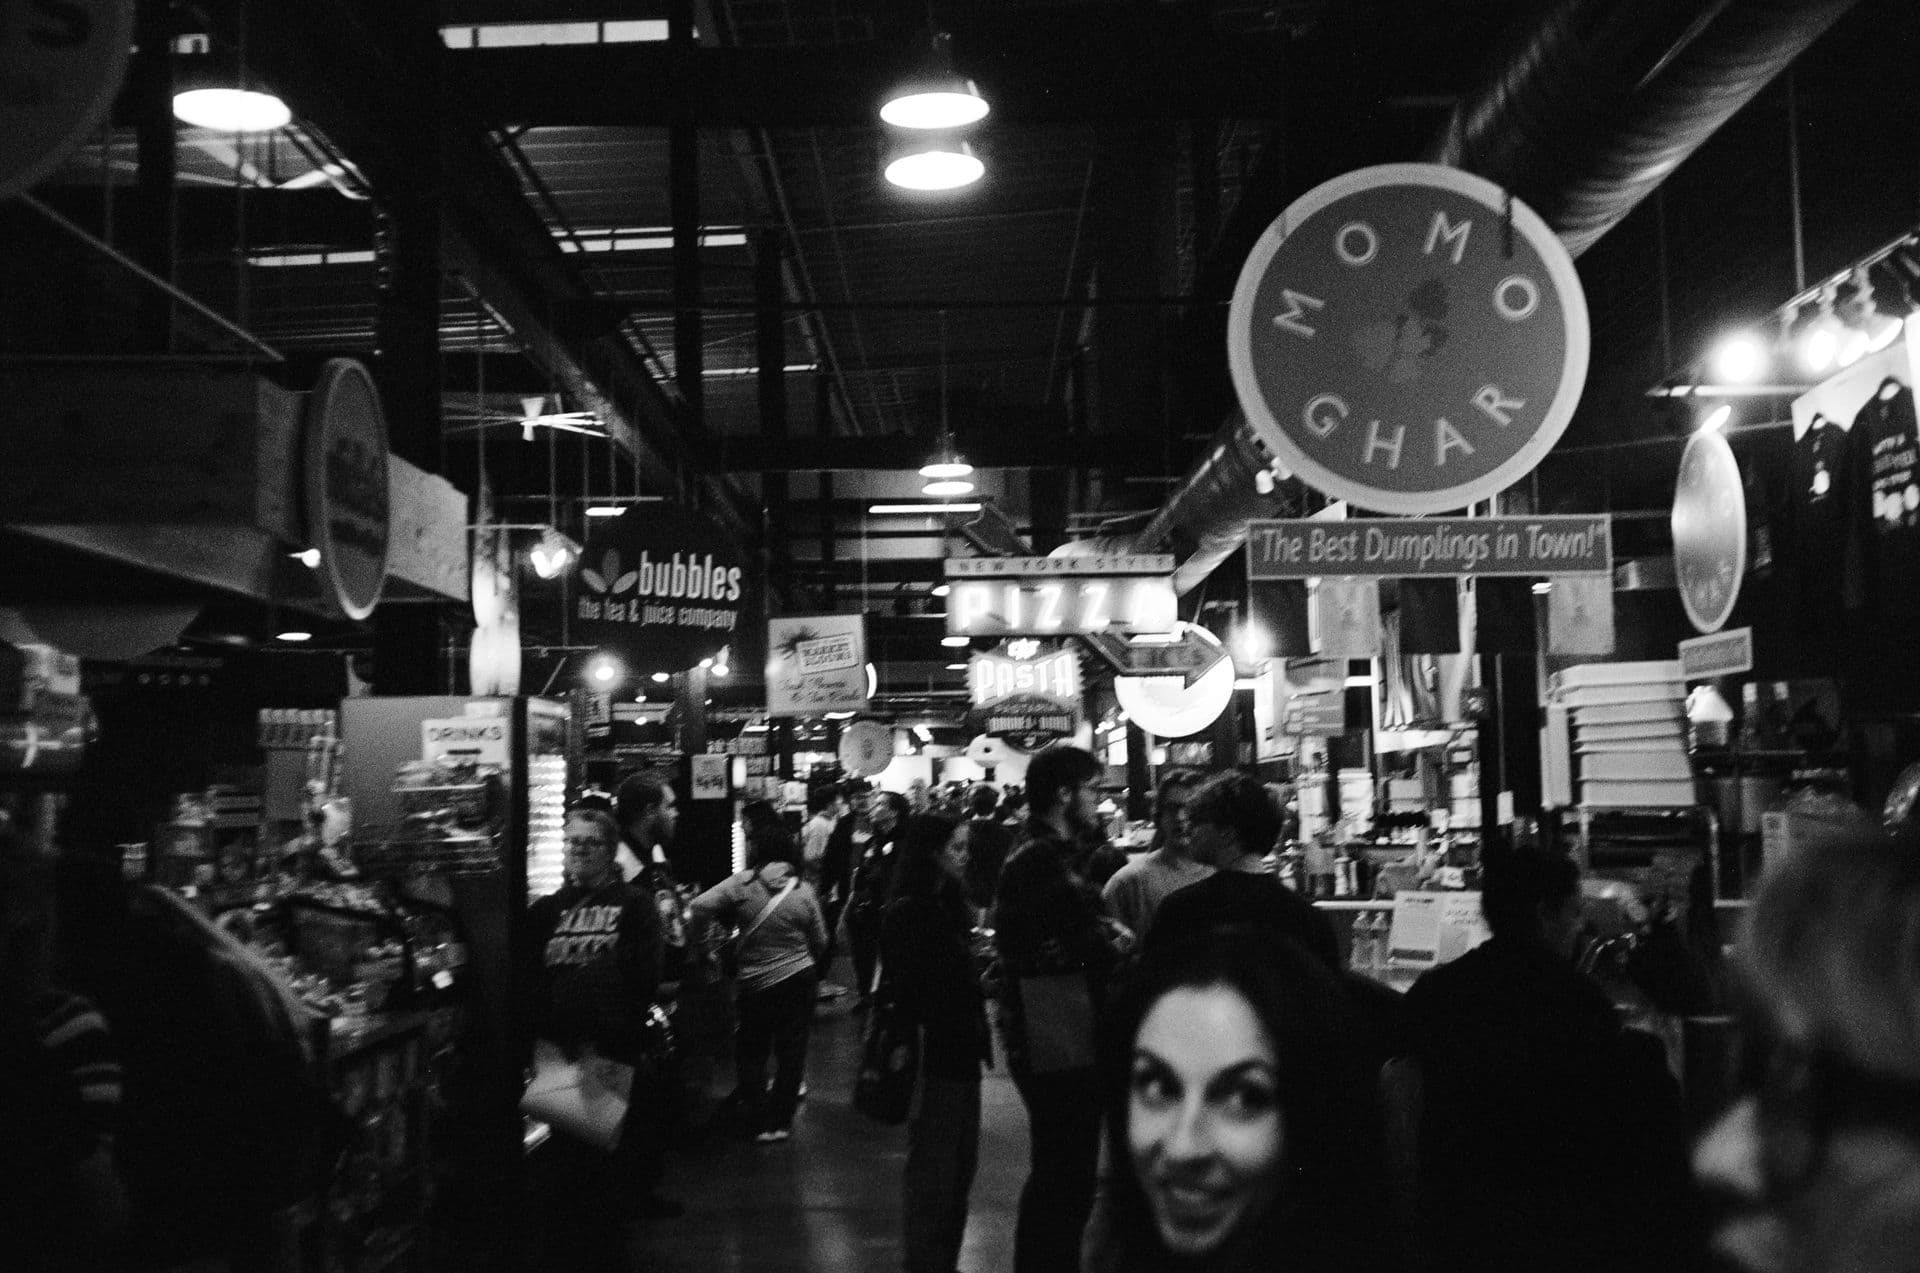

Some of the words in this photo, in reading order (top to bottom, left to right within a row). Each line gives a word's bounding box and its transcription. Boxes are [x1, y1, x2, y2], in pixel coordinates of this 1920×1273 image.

[1272, 210, 1541, 337] MOMO
[1303, 383, 1528, 471] GHAR
[959, 556, 1003, 572] NEW
[1021, 555, 1080, 570] YORK
[1095, 553, 1165, 569] STYLE
[1308, 527, 1360, 563] Best
[1363, 526, 1489, 571] Dumplings
[1496, 524, 1520, 560] in
[638, 550, 742, 601] bubbles
[577, 597, 600, 620] the
[603, 598, 626, 622] tea
[628, 598, 640, 623] &
[640, 600, 676, 628] juice
[677, 607, 738, 632] company
[956, 582, 1165, 630] PIZZA
[975, 653, 1074, 705] PASTA
[429, 727, 502, 742] DRINKS
